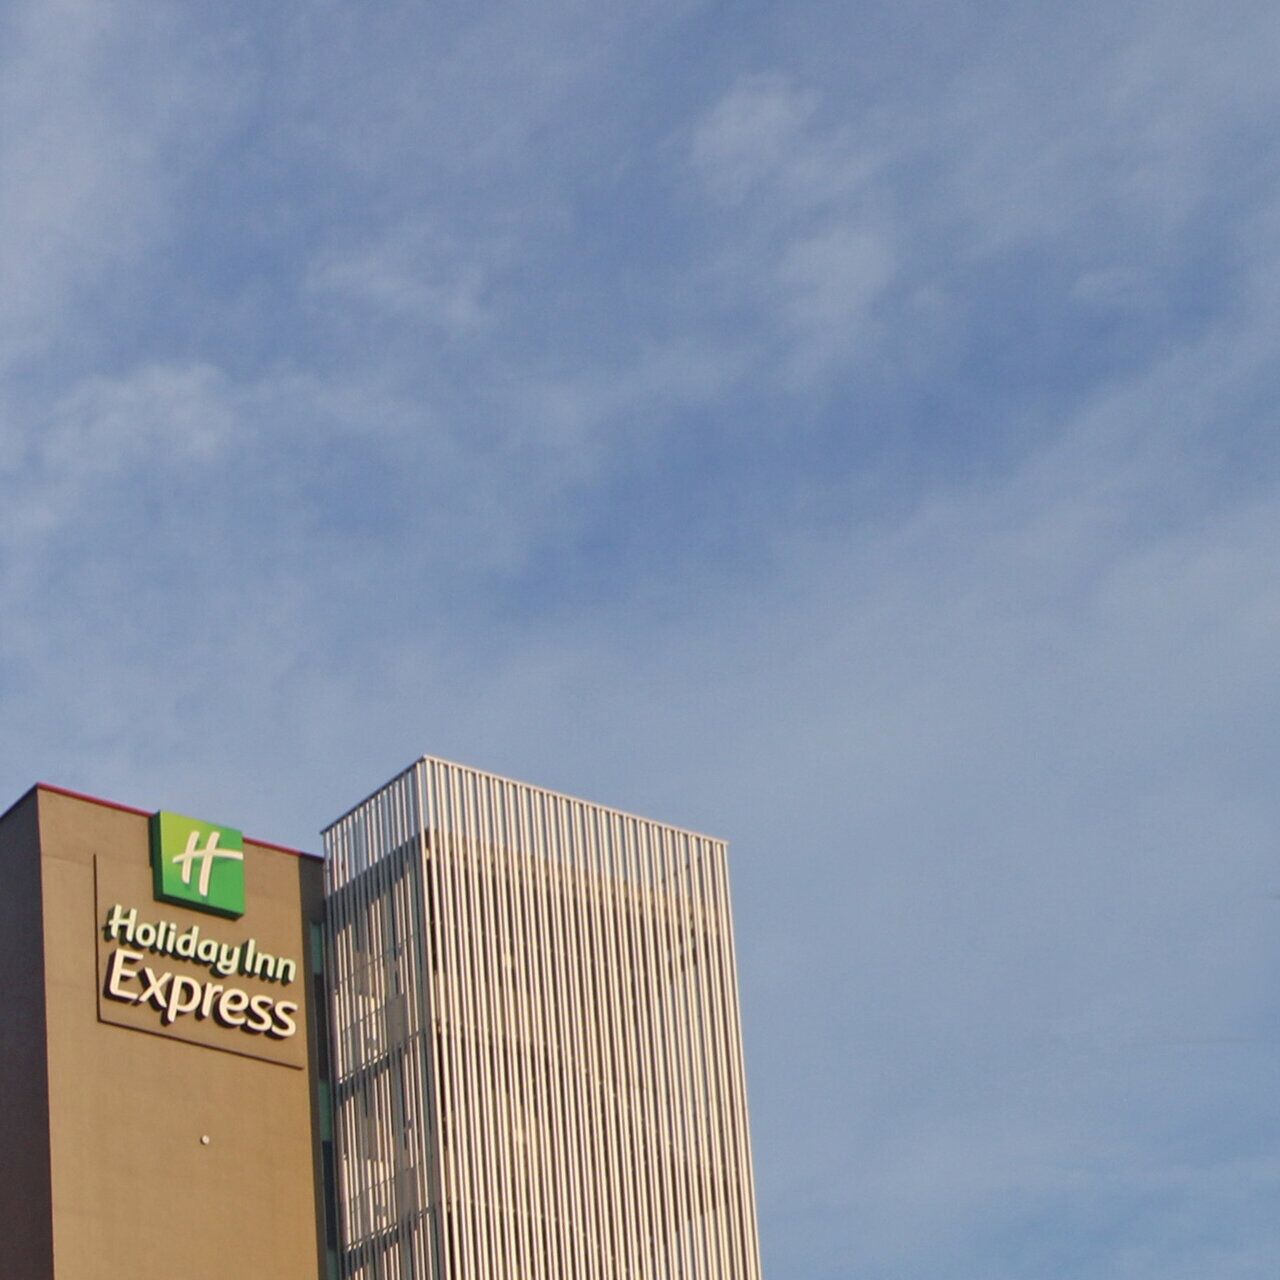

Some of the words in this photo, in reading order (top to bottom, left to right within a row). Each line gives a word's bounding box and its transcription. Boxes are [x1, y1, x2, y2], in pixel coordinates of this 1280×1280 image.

[172, 830, 244, 897] H
[108, 904, 239, 975] Holiday
[245, 938, 297, 983] Inn
[109, 948, 298, 1037] Express
